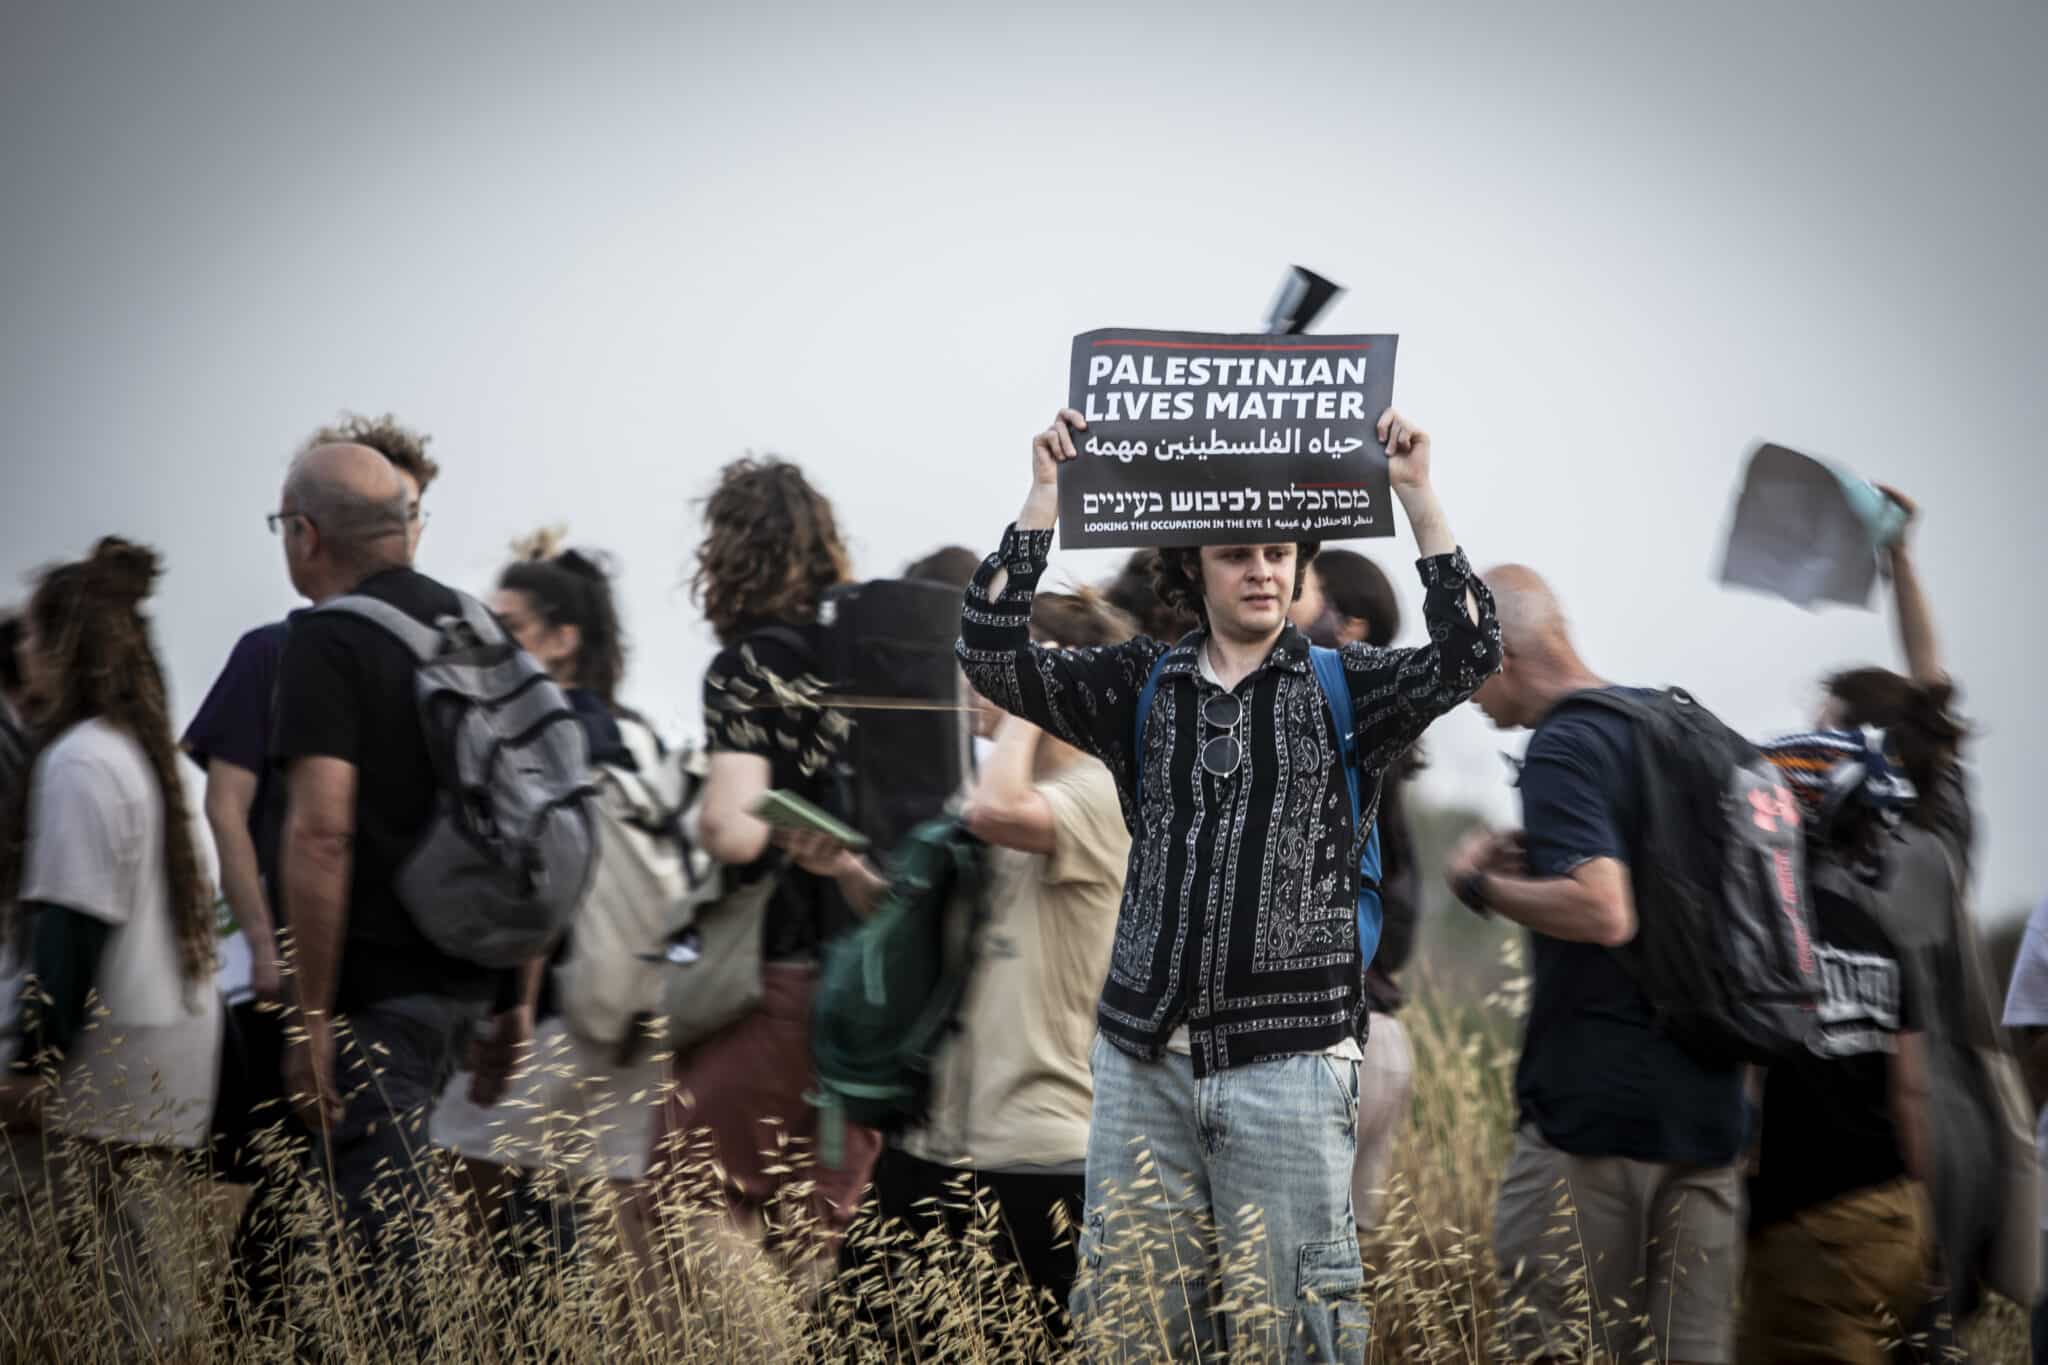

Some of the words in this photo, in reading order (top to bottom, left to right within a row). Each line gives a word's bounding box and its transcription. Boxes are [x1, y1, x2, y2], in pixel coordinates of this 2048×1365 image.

[1087, 354, 1367, 386] PALESTINIAN
[1084, 391, 1195, 422] LIVES
[1205, 391, 1366, 420] MATTER
[1082, 491, 1164, 519] בעיניים
[1170, 487, 1262, 512] לכיבוש
[1267, 481, 1371, 511] מסתכלים
[1084, 521, 1129, 533] LOOKING
[1130, 520, 1149, 531] THE
[1150, 519, 1211, 531] OCCUPATION
[1212, 519, 1225, 530] IN
[1225, 519, 1245, 530] THE
[1245, 519, 1264, 529] EYE
